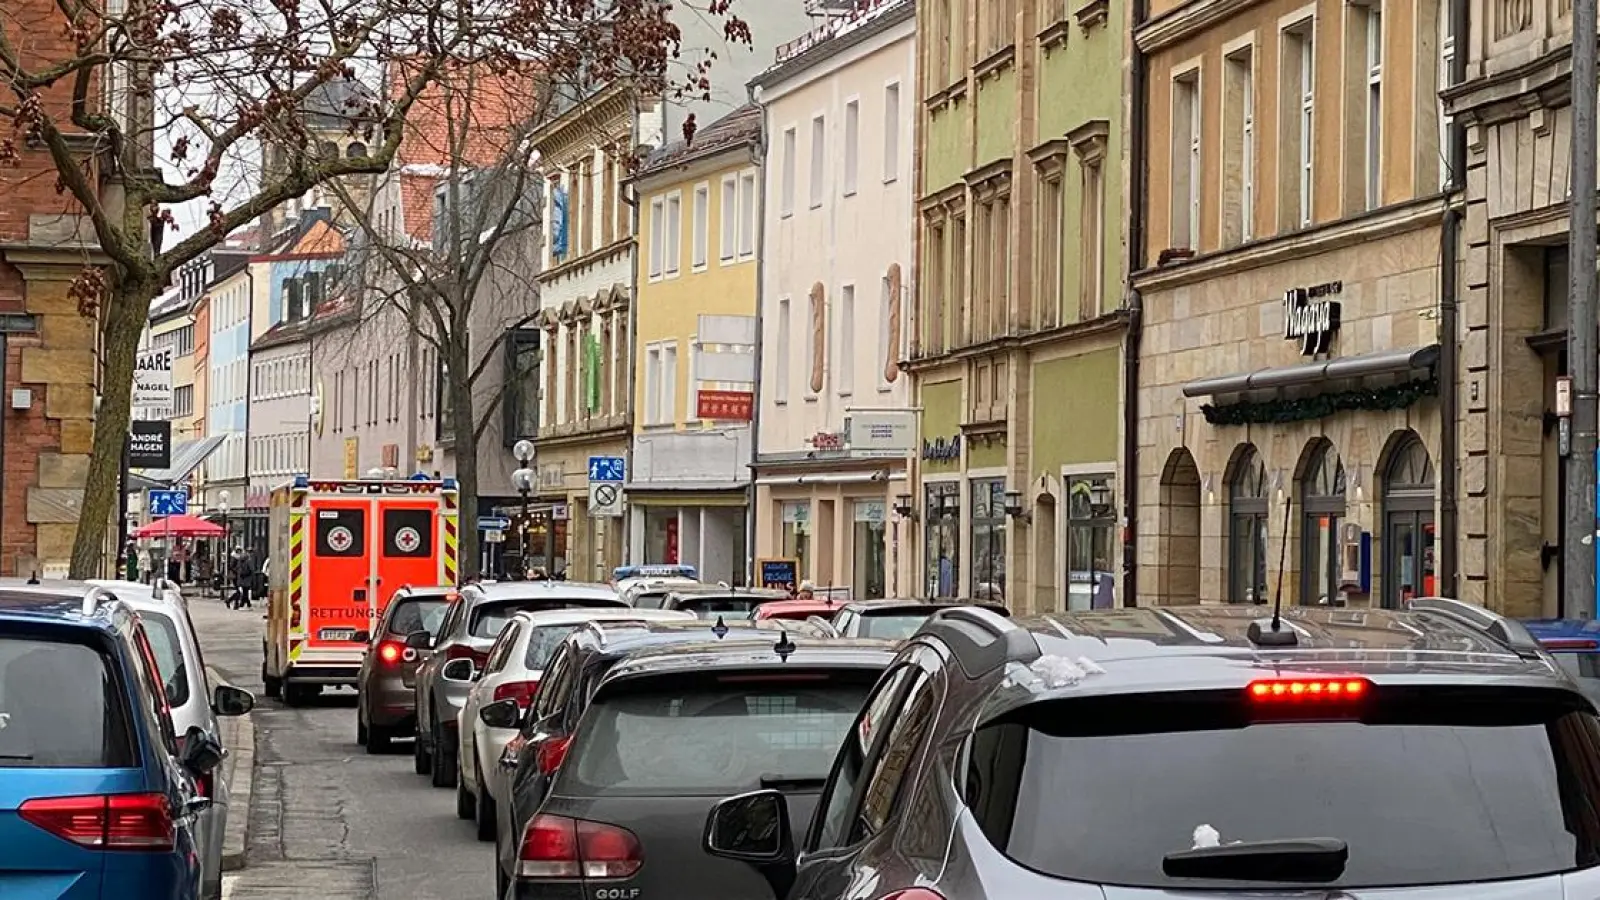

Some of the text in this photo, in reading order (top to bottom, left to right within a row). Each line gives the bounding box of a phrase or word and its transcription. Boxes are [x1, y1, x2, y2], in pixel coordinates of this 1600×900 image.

[1283, 289, 1332, 355] Wagaya
[130, 443, 164, 451] HAGEN
[311, 607, 383, 619] RETTUNGS
[596, 889, 640, 899] GOLF
